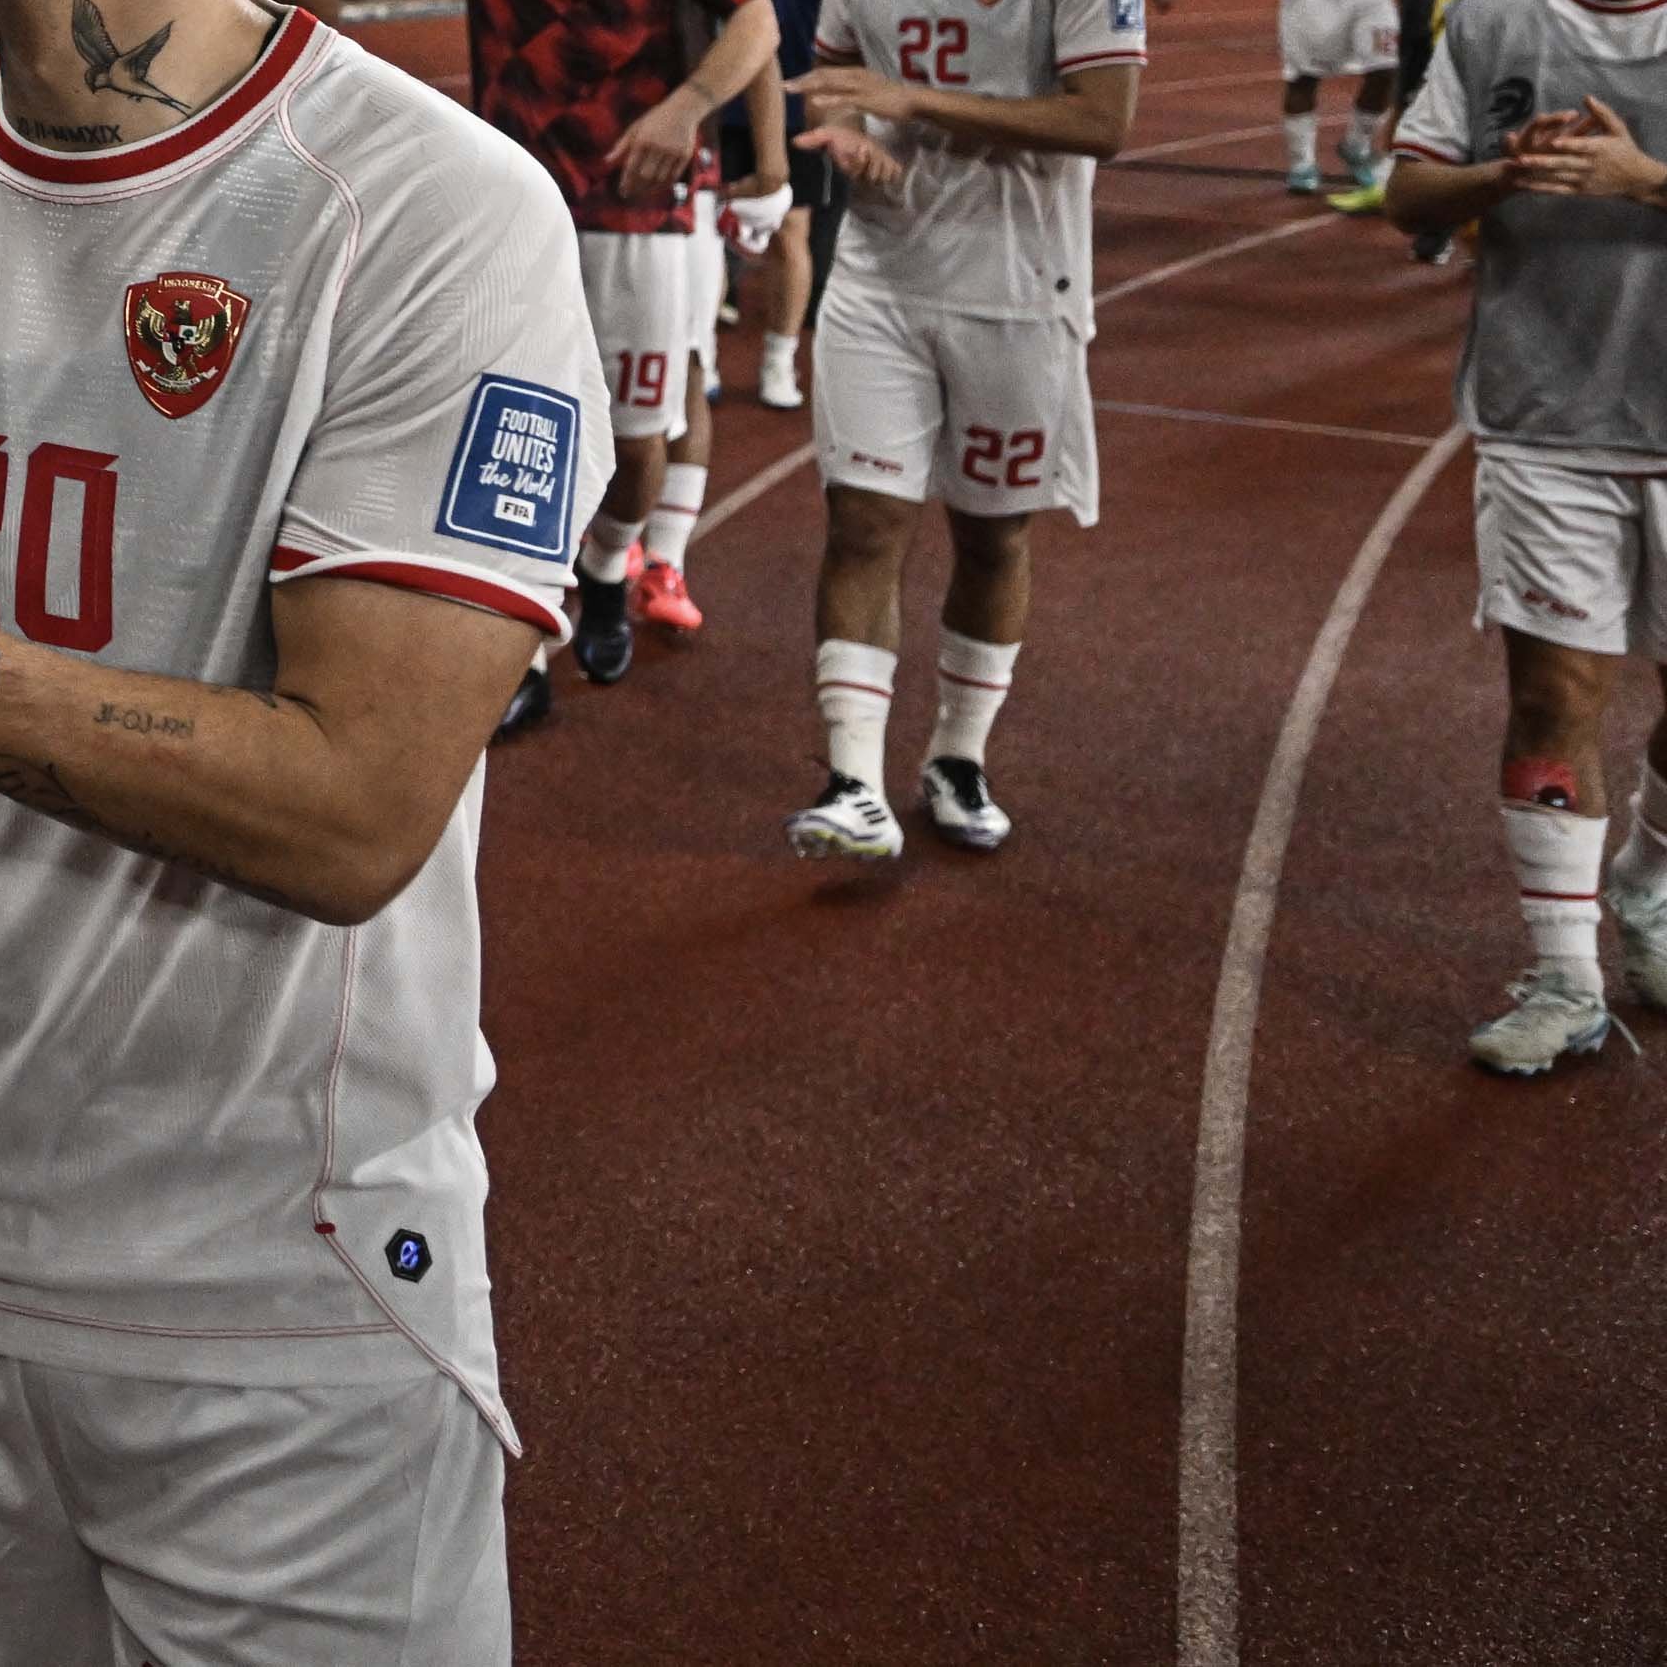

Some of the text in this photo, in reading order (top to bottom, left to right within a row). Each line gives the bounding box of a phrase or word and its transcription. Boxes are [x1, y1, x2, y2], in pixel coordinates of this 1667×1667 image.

[898, 17, 970, 84] 22
[617, 349, 667, 408] 19
[499, 407, 558, 443] FOOTBALL
[491, 430, 556, 474] UNITES
[963, 425, 1046, 488] 22
[479, 462, 556, 503] the World
[502, 501, 530, 520] FIFA
